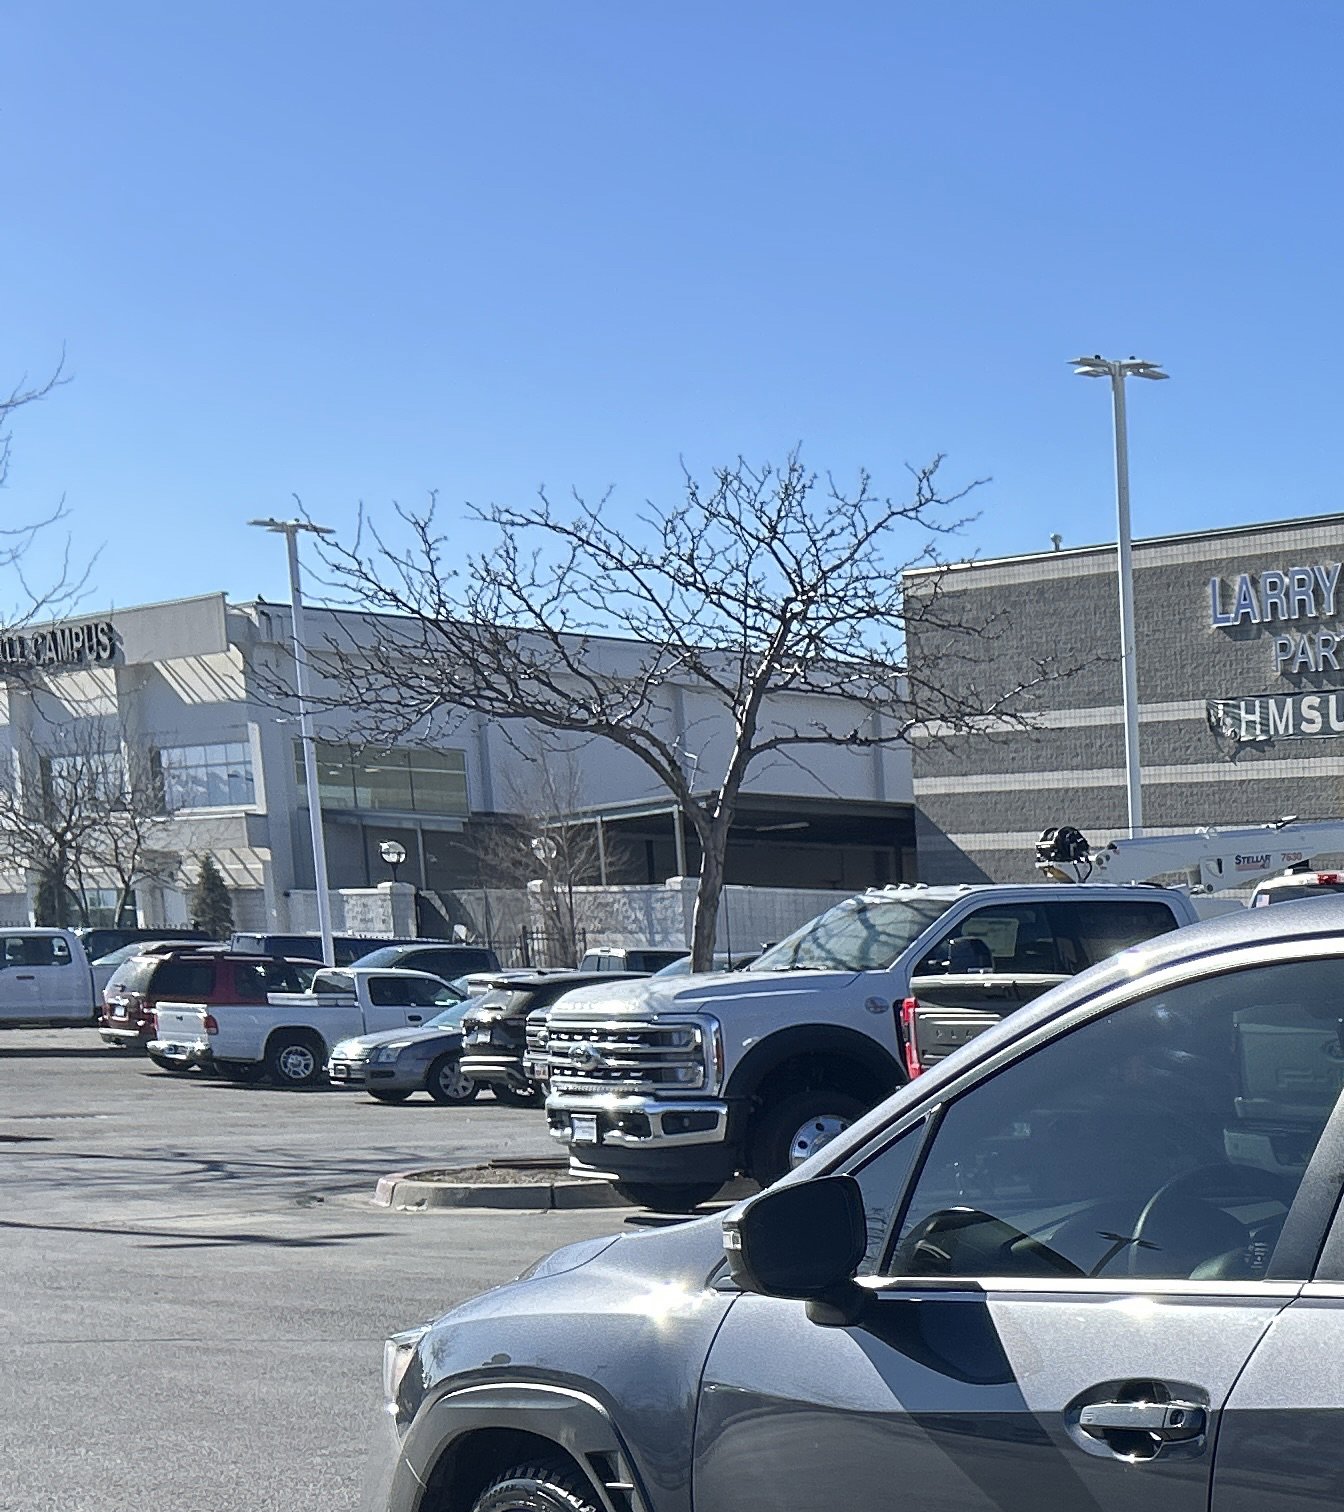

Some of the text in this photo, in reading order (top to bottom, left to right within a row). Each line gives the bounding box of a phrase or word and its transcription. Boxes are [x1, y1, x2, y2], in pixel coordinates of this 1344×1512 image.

[1210, 563, 1343, 628] LARRY
[32, 621, 114, 663] CAMPUS
[1235, 854, 1271, 865] STELLAR
